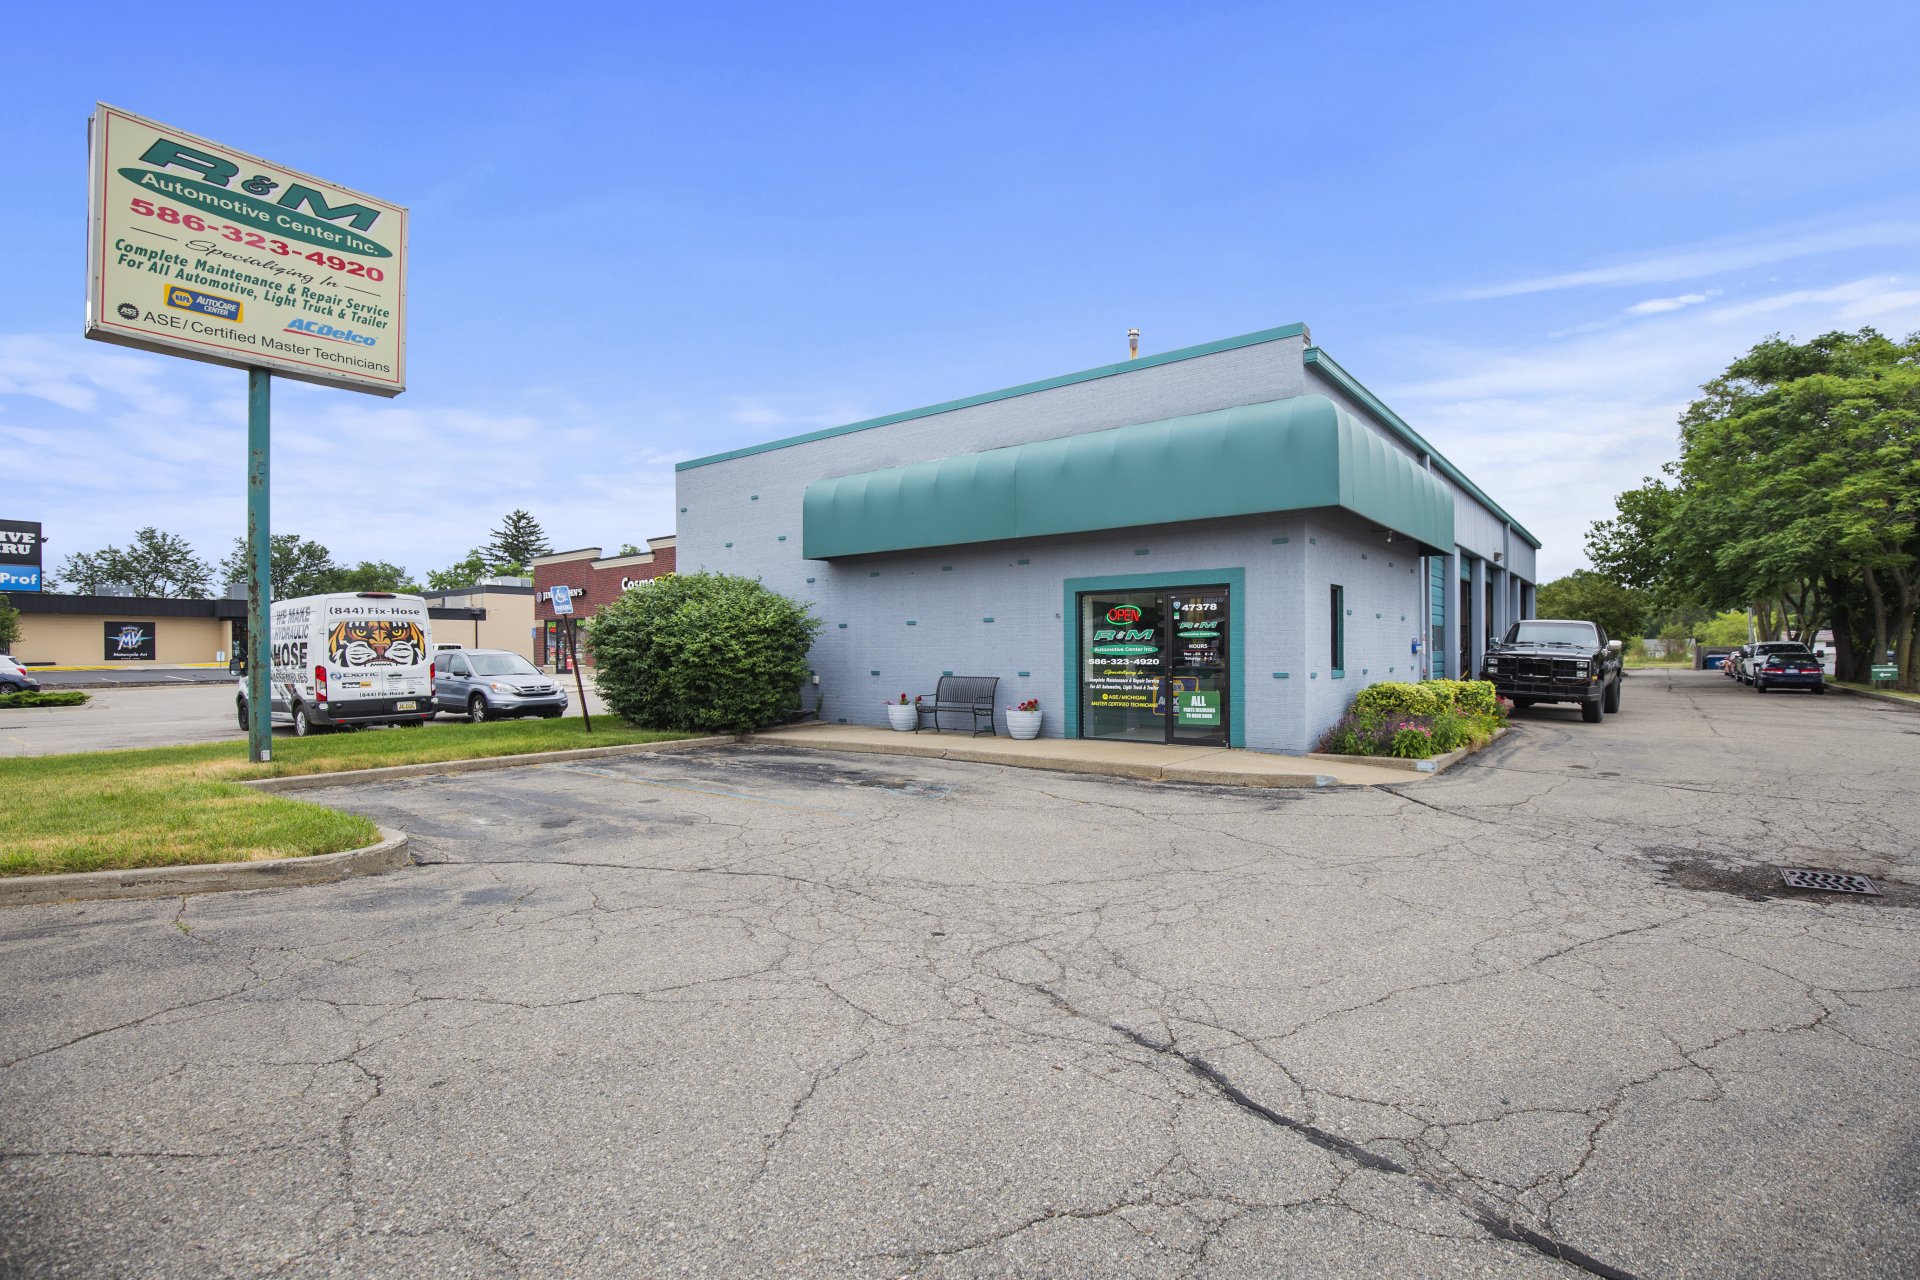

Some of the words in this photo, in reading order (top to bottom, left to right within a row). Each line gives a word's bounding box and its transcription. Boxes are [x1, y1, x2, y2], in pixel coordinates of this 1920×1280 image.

[141, 173, 270, 222] Automotive
[276, 215, 343, 243] Center
[347, 235, 379, 255] Inc.
[130, 198, 384, 282] 586-323-4920
[185, 240, 314, 285] Specializing
[319, 275, 338, 288] In
[115, 238, 188, 267] Complete
[194, 258, 282, 291] Maintenance
[286, 283, 296, 295] &
[301, 286, 343, 306] Repair
[345, 298, 390, 318] Service
[118, 253, 144, 270] For
[148, 261, 170, 276] All
[175, 268, 258, 301] Automotive,
[263, 290, 297, 307] Light
[303, 299, 333, 317] Truck
[338, 308, 347, 320] &
[351, 311, 388, 329] Trailer
[175, 293, 191, 304] NAPA
[203, 305, 229, 317] CENTER
[287, 317, 377, 347] ACDelco
[261, 336, 310, 355] Master
[313, 347, 390, 373] Technicians
[0, 543, 31, 555] RU
[276, 609, 287, 626] WE
[287, 605, 311, 624] MAKE
[329, 606, 364, 616] (844)
[367, 606, 421, 616] Fix-Hose
[1107, 608, 1140, 623] OPEN
[1181, 603, 1218, 611] 47378
[117, 629, 144, 651] MV
[273, 624, 309, 641] HYDRAULIC
[273, 642, 308, 669] HOSE
[377, 690, 404, 698] Fix-Hose
[1190, 695, 1206, 707] ALL
